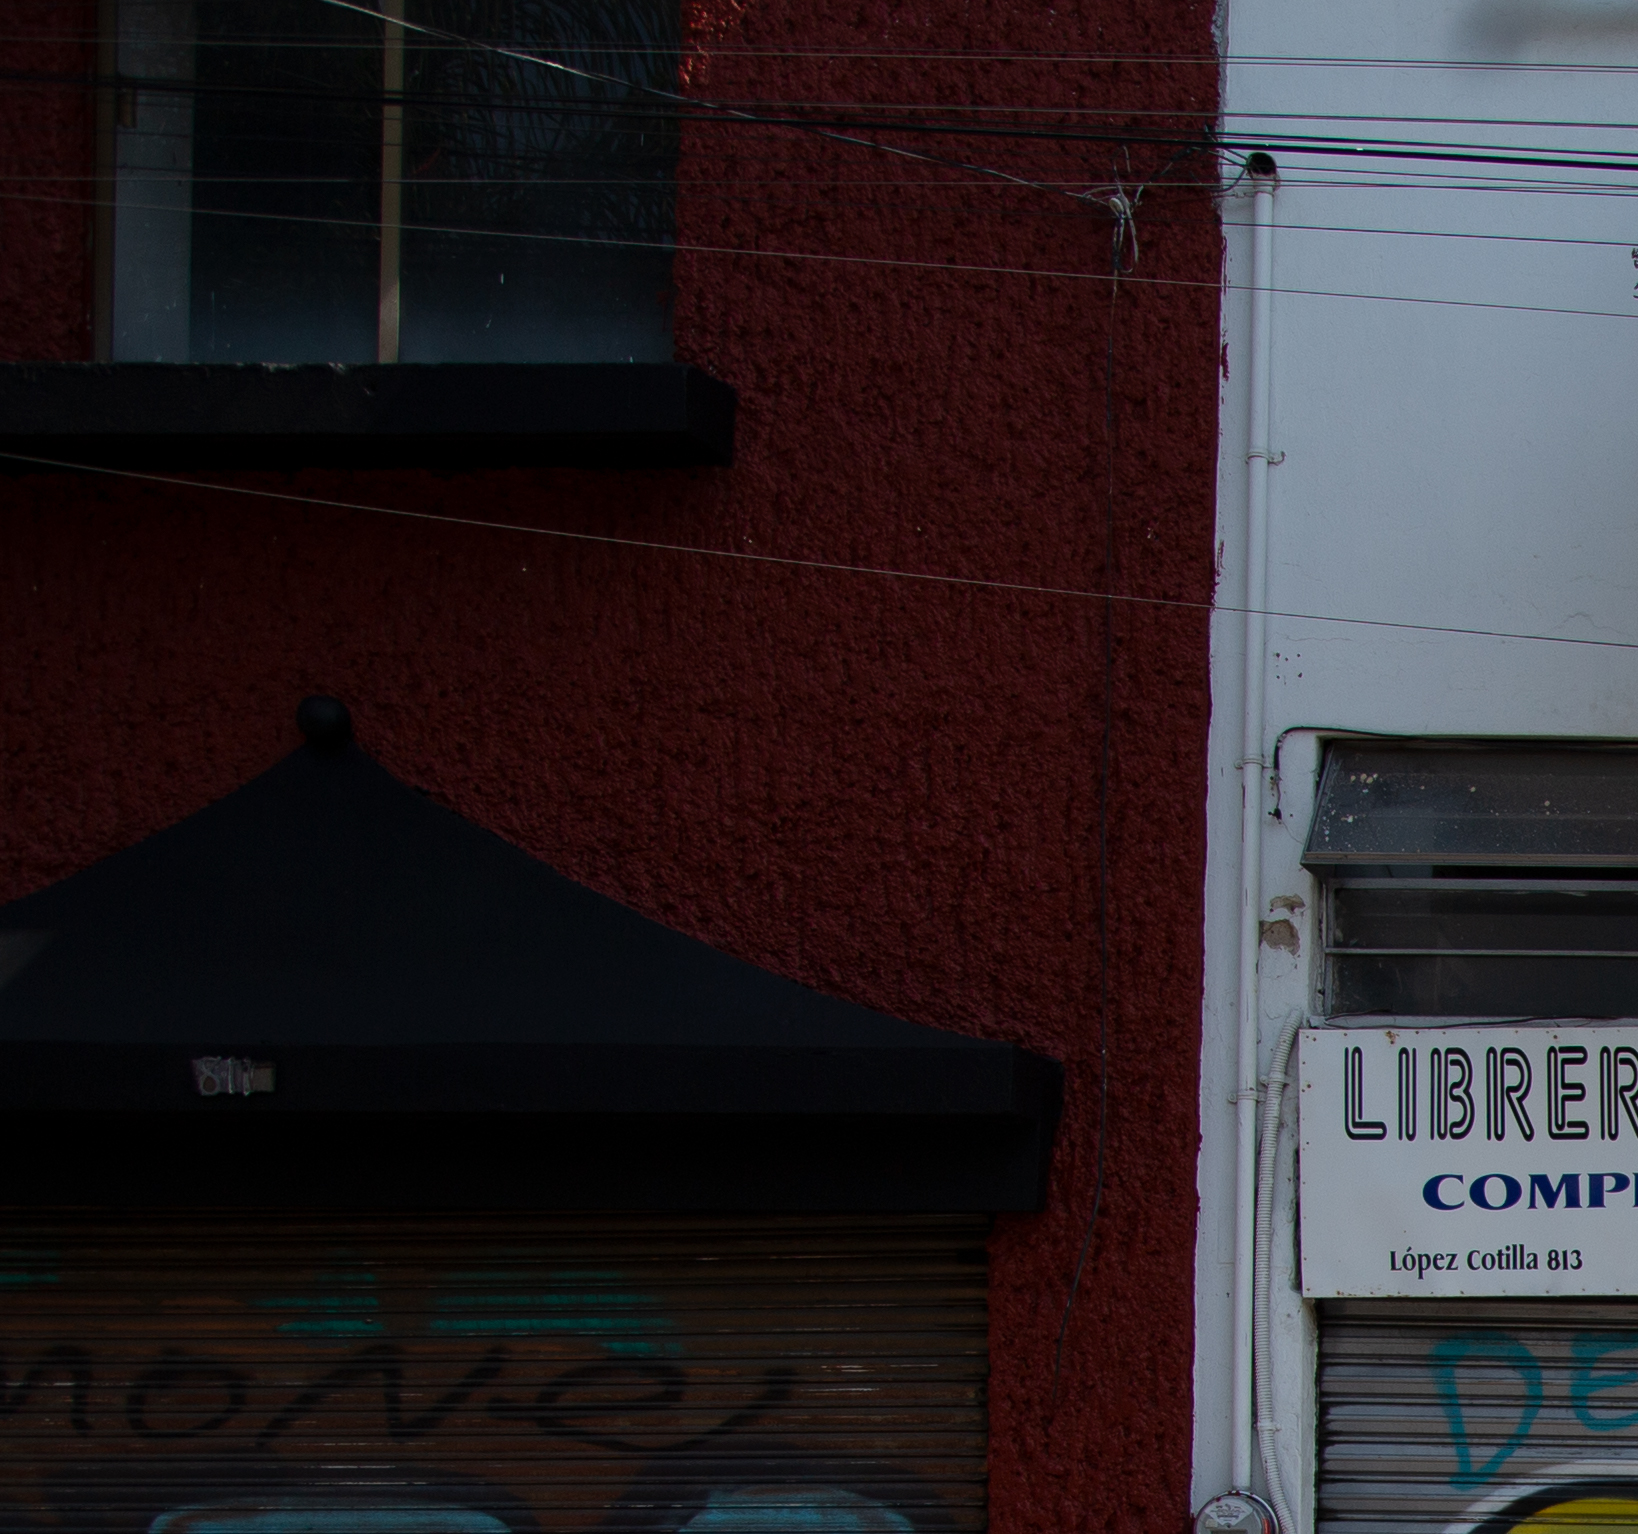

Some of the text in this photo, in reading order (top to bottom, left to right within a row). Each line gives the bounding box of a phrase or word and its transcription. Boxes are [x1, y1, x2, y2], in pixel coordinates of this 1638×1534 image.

[1390, 1243, 1583, 1280] López Cotilla 813
